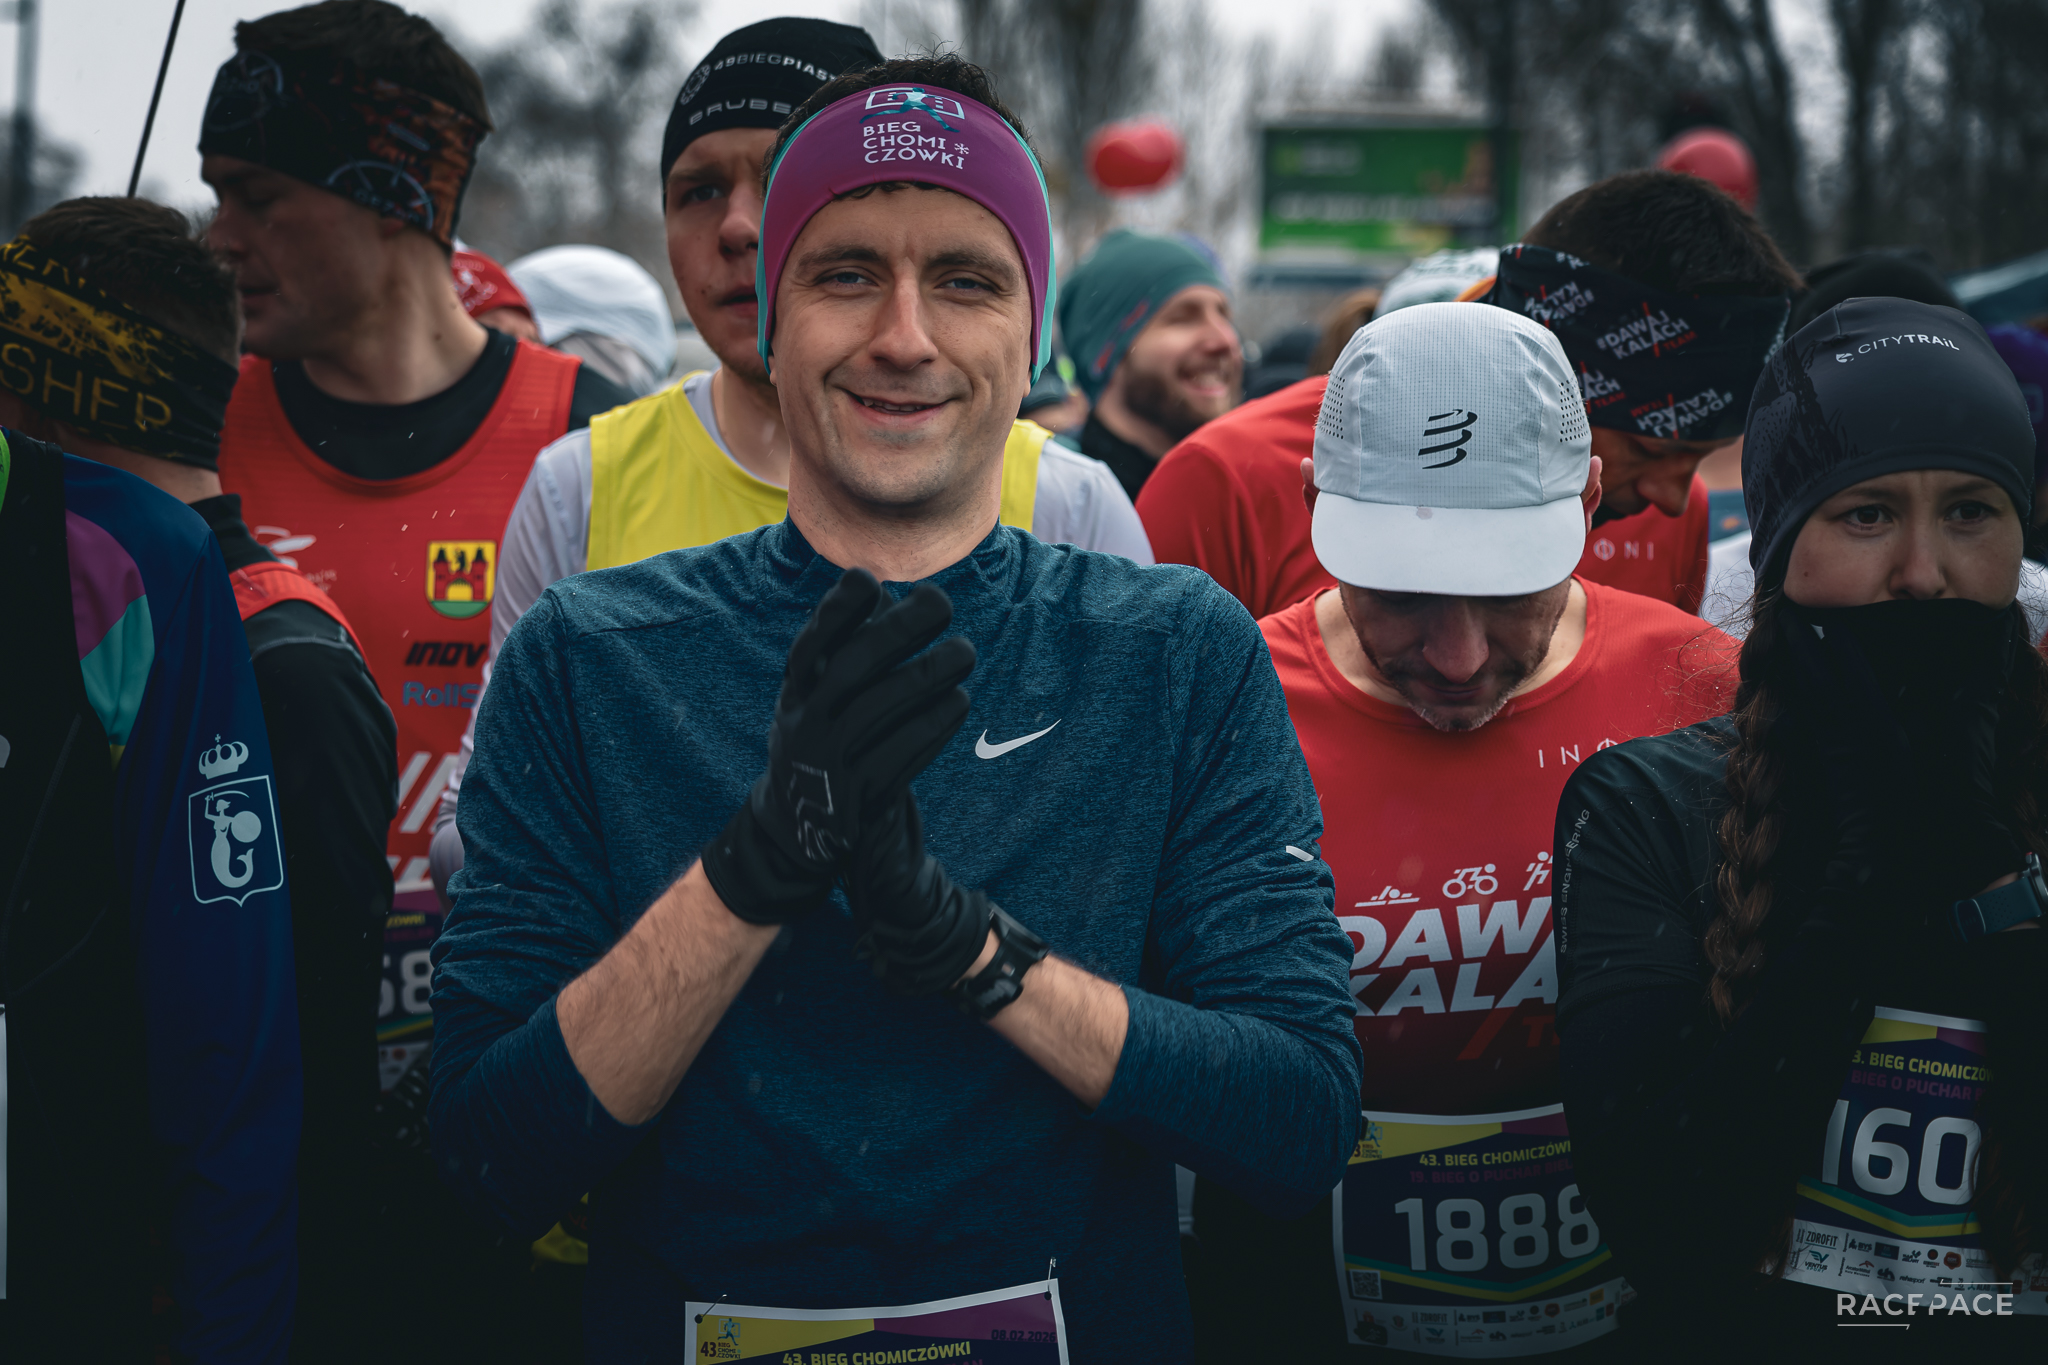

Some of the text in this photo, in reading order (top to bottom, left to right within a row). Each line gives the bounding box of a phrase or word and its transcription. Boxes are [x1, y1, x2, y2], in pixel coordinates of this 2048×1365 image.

[689, 98, 794, 126] BRUBE
[863, 121, 921, 137] BIEG
[863, 134, 946, 150] CHOMI
[864, 147, 965, 170] CZÓWKI
[1612, 318, 1690, 361] KALACH
[1663, 331, 1698, 352] TEAM
[1595, 391, 1627, 408] TEAM
[1852, 1050, 1865, 1064] 3.
[1869, 1052, 1905, 1070] BIEG
[1851, 1070, 1888, 1088] BIEG
[1891, 1076, 1903, 1090] O
[1906, 1078, 1972, 1101] PUCHAR
[1409, 1158, 1573, 1183] 19. BIEG O PUCHAR BIEL
[1419, 1154, 1441, 1166] 43.
[1445, 1154, 1478, 1166] BIEG
[1394, 1183, 1600, 1272] 1888
[1804, 1261, 1828, 1270] VENTUS
[991, 1329, 1057, 1342] 08.02.2026
[811, 1353, 847, 1365] BIEG
[852, 1341, 971, 1365] CHOMICZÓWKI
